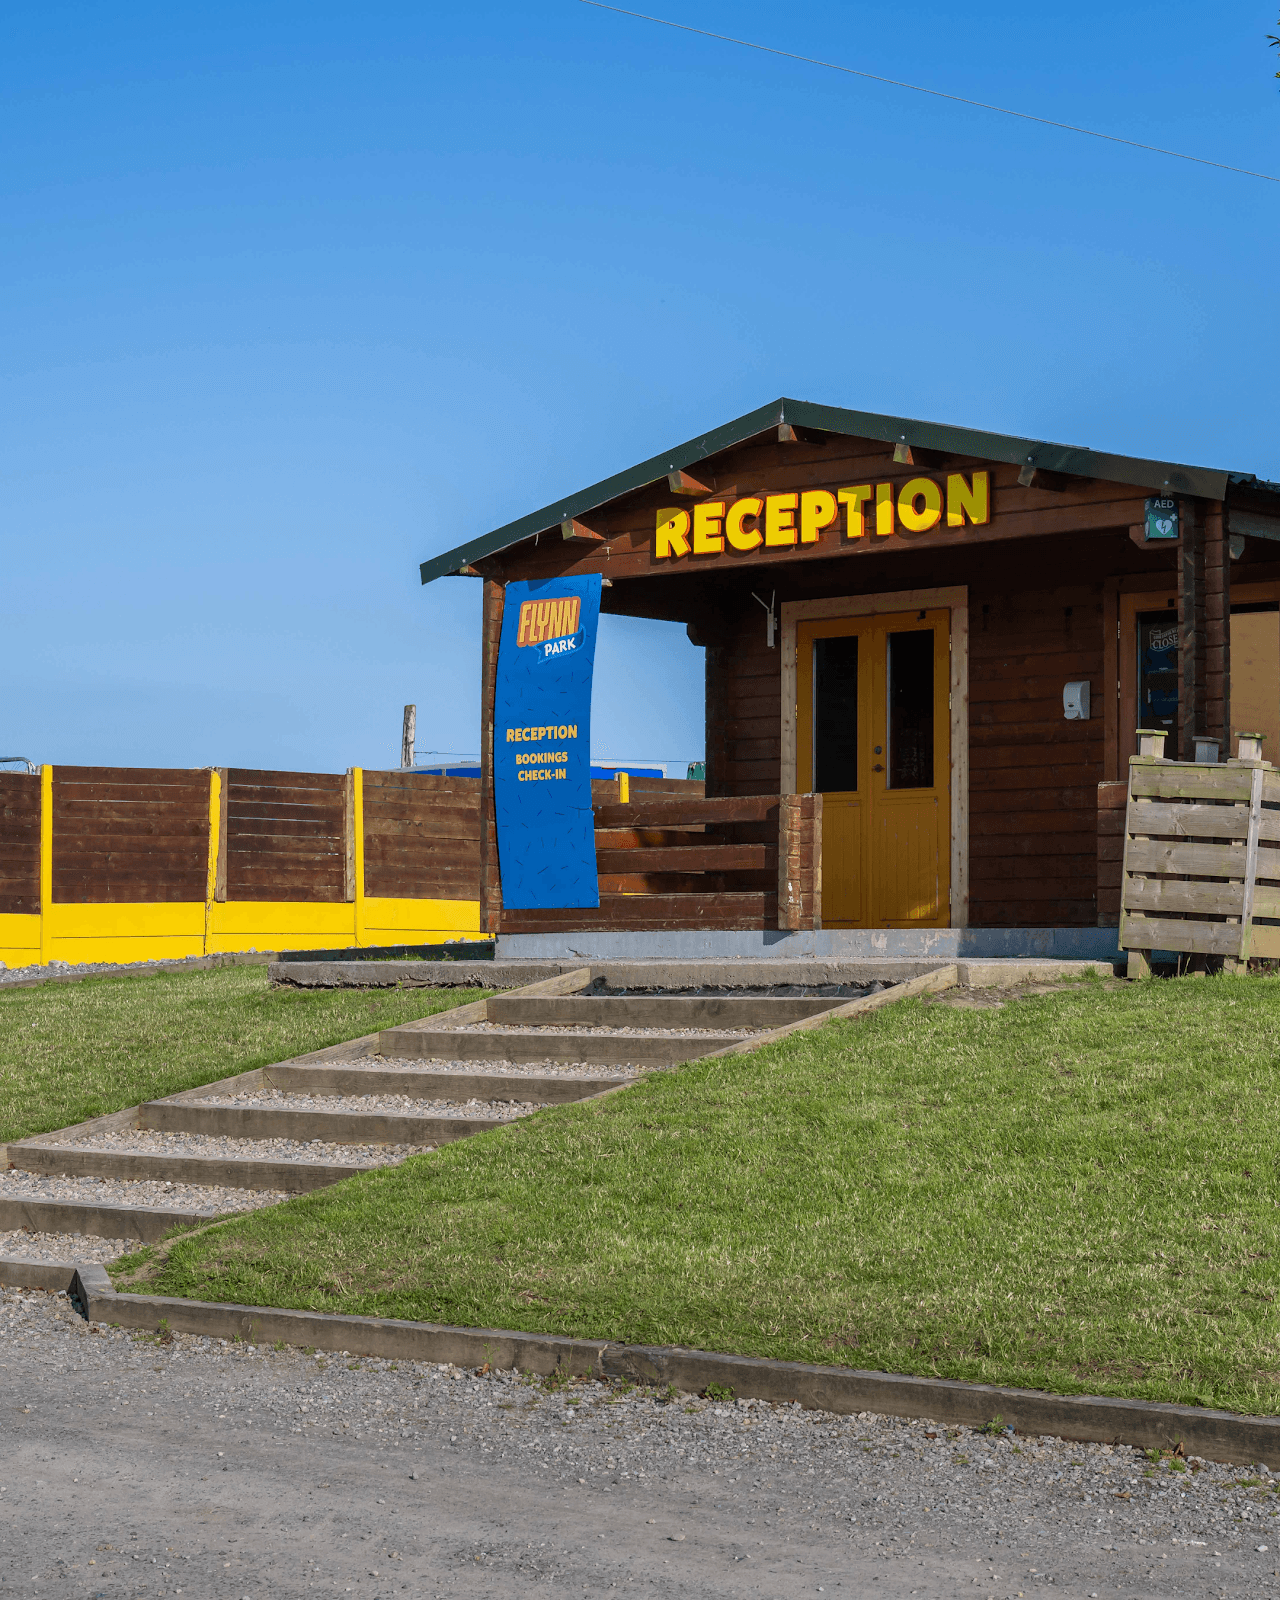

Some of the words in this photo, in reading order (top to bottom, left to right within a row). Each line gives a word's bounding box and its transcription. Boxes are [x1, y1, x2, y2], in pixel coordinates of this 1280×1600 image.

[1153, 499, 1175, 509] AED
[655, 471, 990, 559] RECEPTION
[518, 599, 578, 643] FLYNN
[544, 637, 576, 657] PARK
[1152, 633, 1178, 649] CLOSE
[506, 724, 578, 742] RECEPTION
[515, 751, 569, 765] BOOKINGS
[517, 768, 567, 782] CHECK-IN
